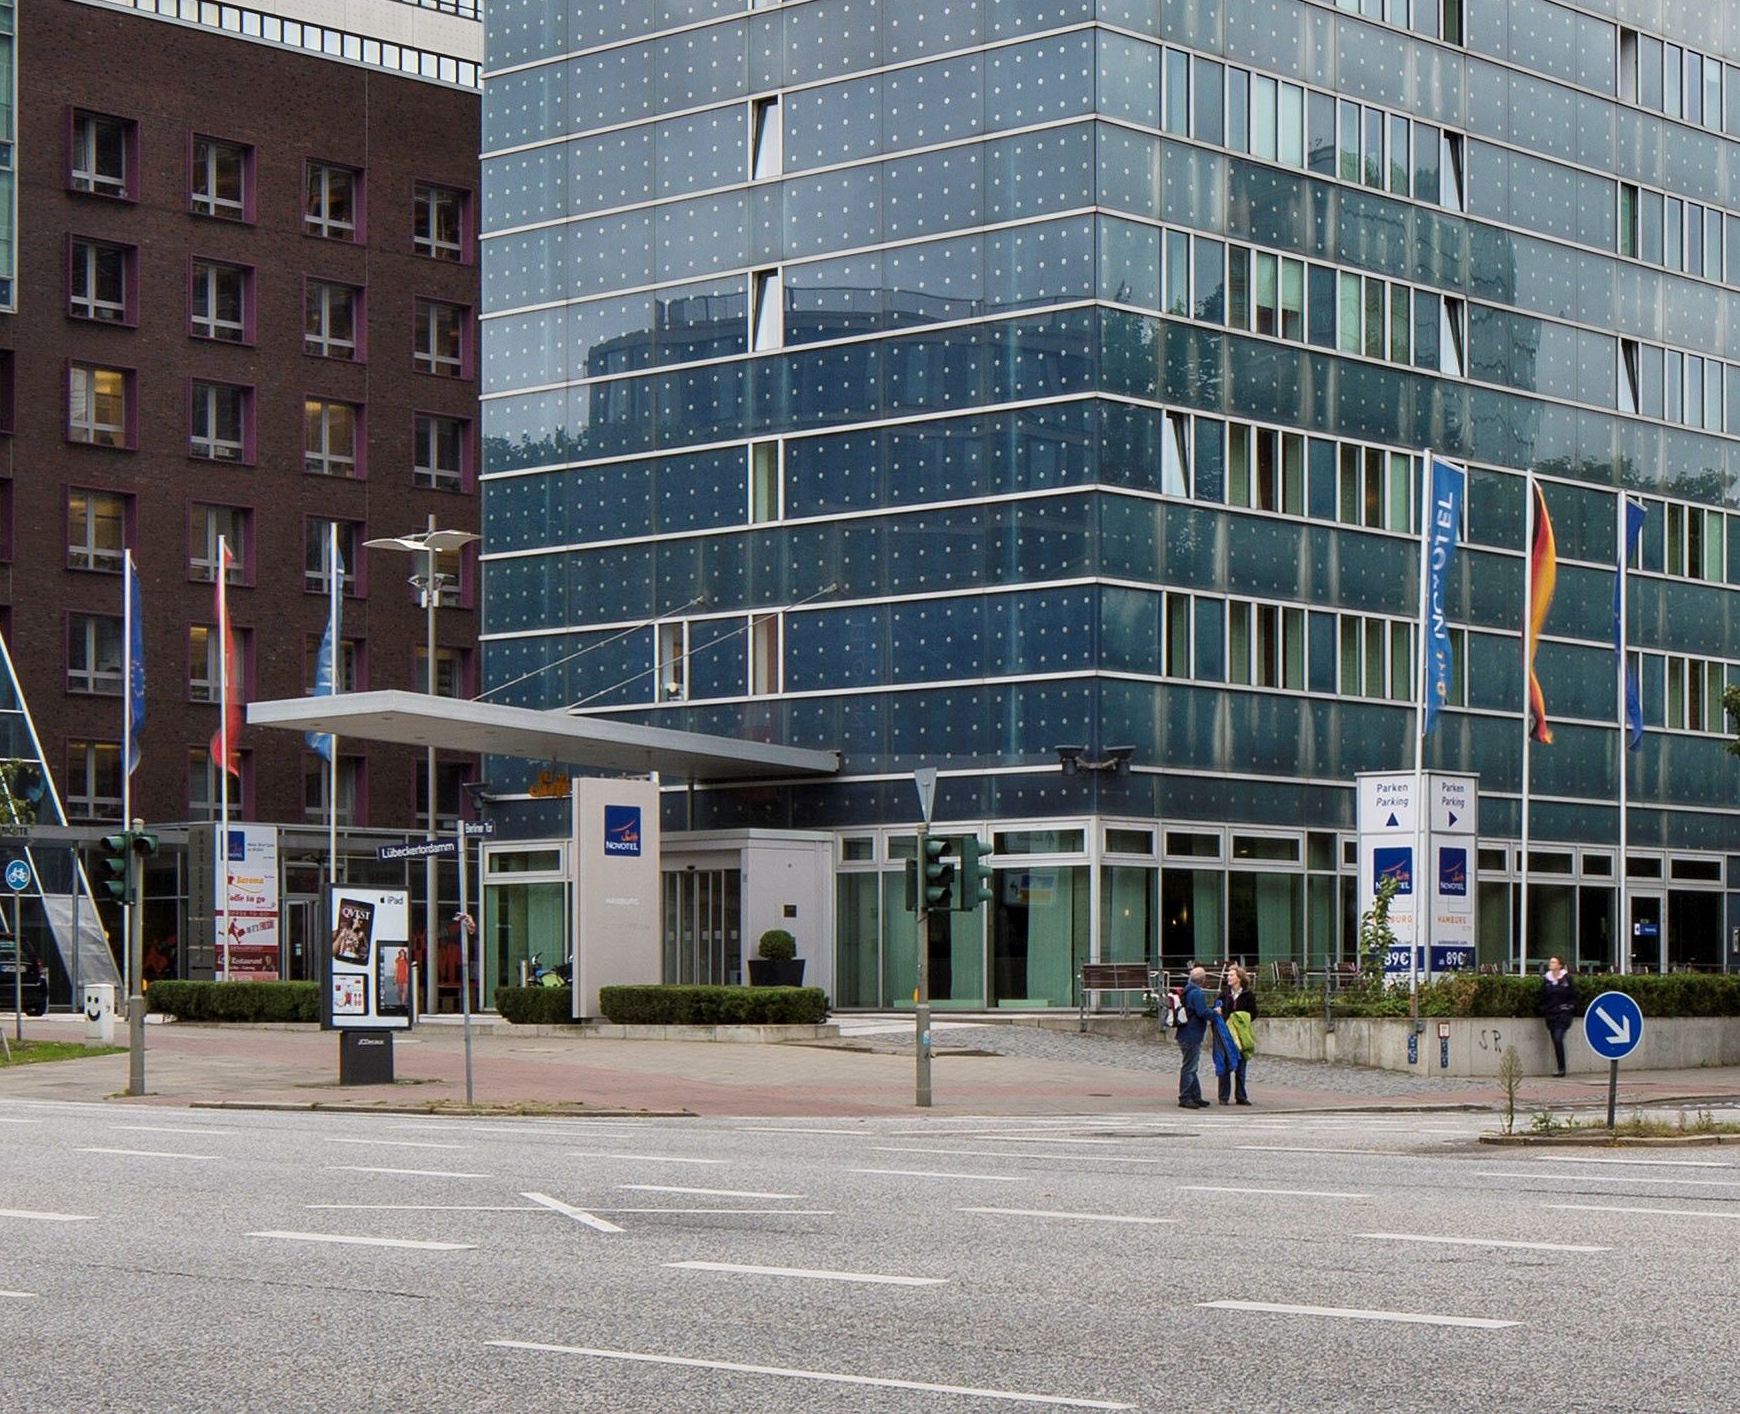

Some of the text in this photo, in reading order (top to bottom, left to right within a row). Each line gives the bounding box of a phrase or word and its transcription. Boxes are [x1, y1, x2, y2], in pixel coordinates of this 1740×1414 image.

[1376, 783, 1409, 793] Parken
[1441, 782, 1464, 793] Parken
[1376, 797, 1409, 808] Parking
[1441, 796, 1465, 809] Parking
[606, 841, 639, 851] NOVOTEL
[1375, 882, 1410, 890] NTEL
[1440, 882, 1465, 891] NOVOTEL
[387, 895, 404, 906] iPad
[1438, 915, 1467, 925] HAMBURG
